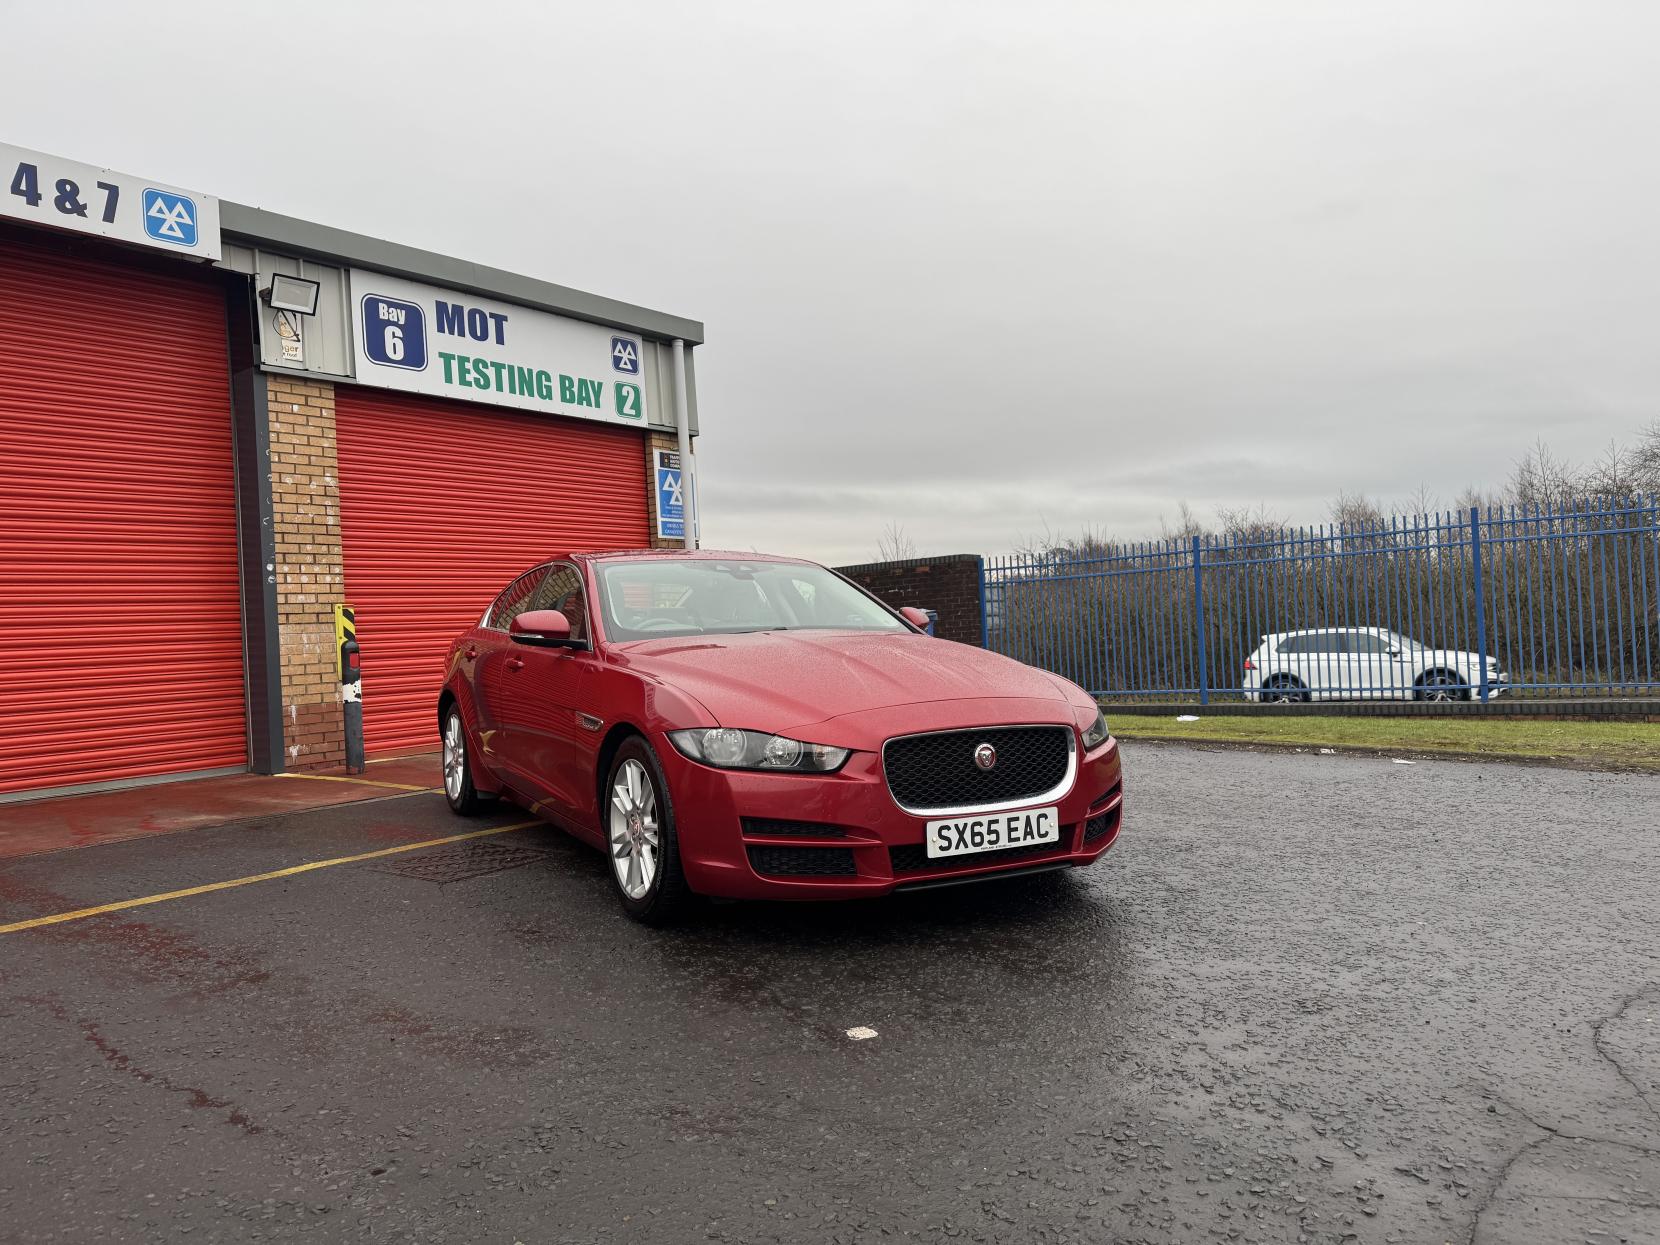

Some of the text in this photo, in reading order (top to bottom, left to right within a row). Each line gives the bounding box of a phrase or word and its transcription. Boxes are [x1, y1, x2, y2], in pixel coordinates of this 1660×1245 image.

[10, 162, 120, 224] 4 & 7
[378, 302, 406, 325] Bay
[434, 300, 509, 346] MOT
[384, 325, 404, 360] 6
[438, 352, 604, 409] TESTING BAY
[621, 384, 637, 416] 2
[937, 813, 1049, 851] SX65 EAC
